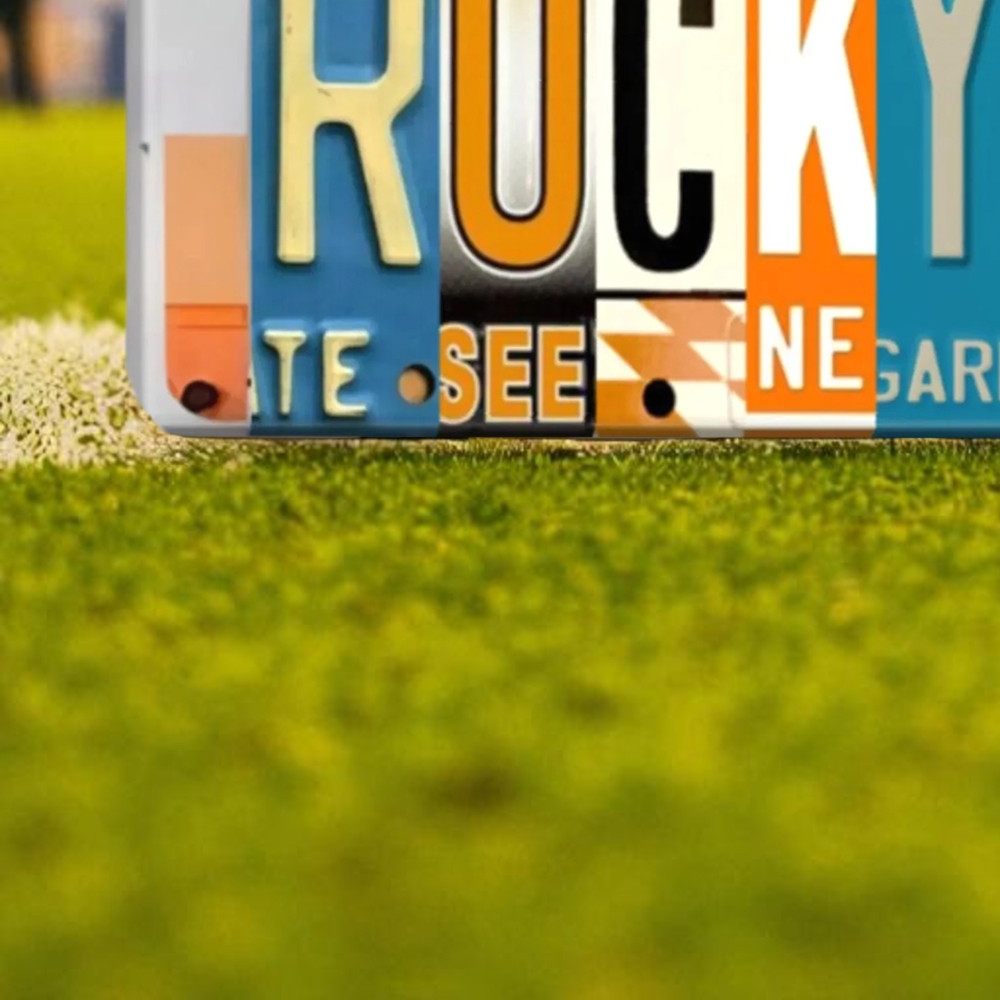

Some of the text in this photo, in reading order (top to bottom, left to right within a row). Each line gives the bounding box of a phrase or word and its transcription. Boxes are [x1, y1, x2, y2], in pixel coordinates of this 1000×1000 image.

[251, 329, 370, 417] TE
[439, 324, 587, 424] SEE
[759, 306, 863, 390] NE
